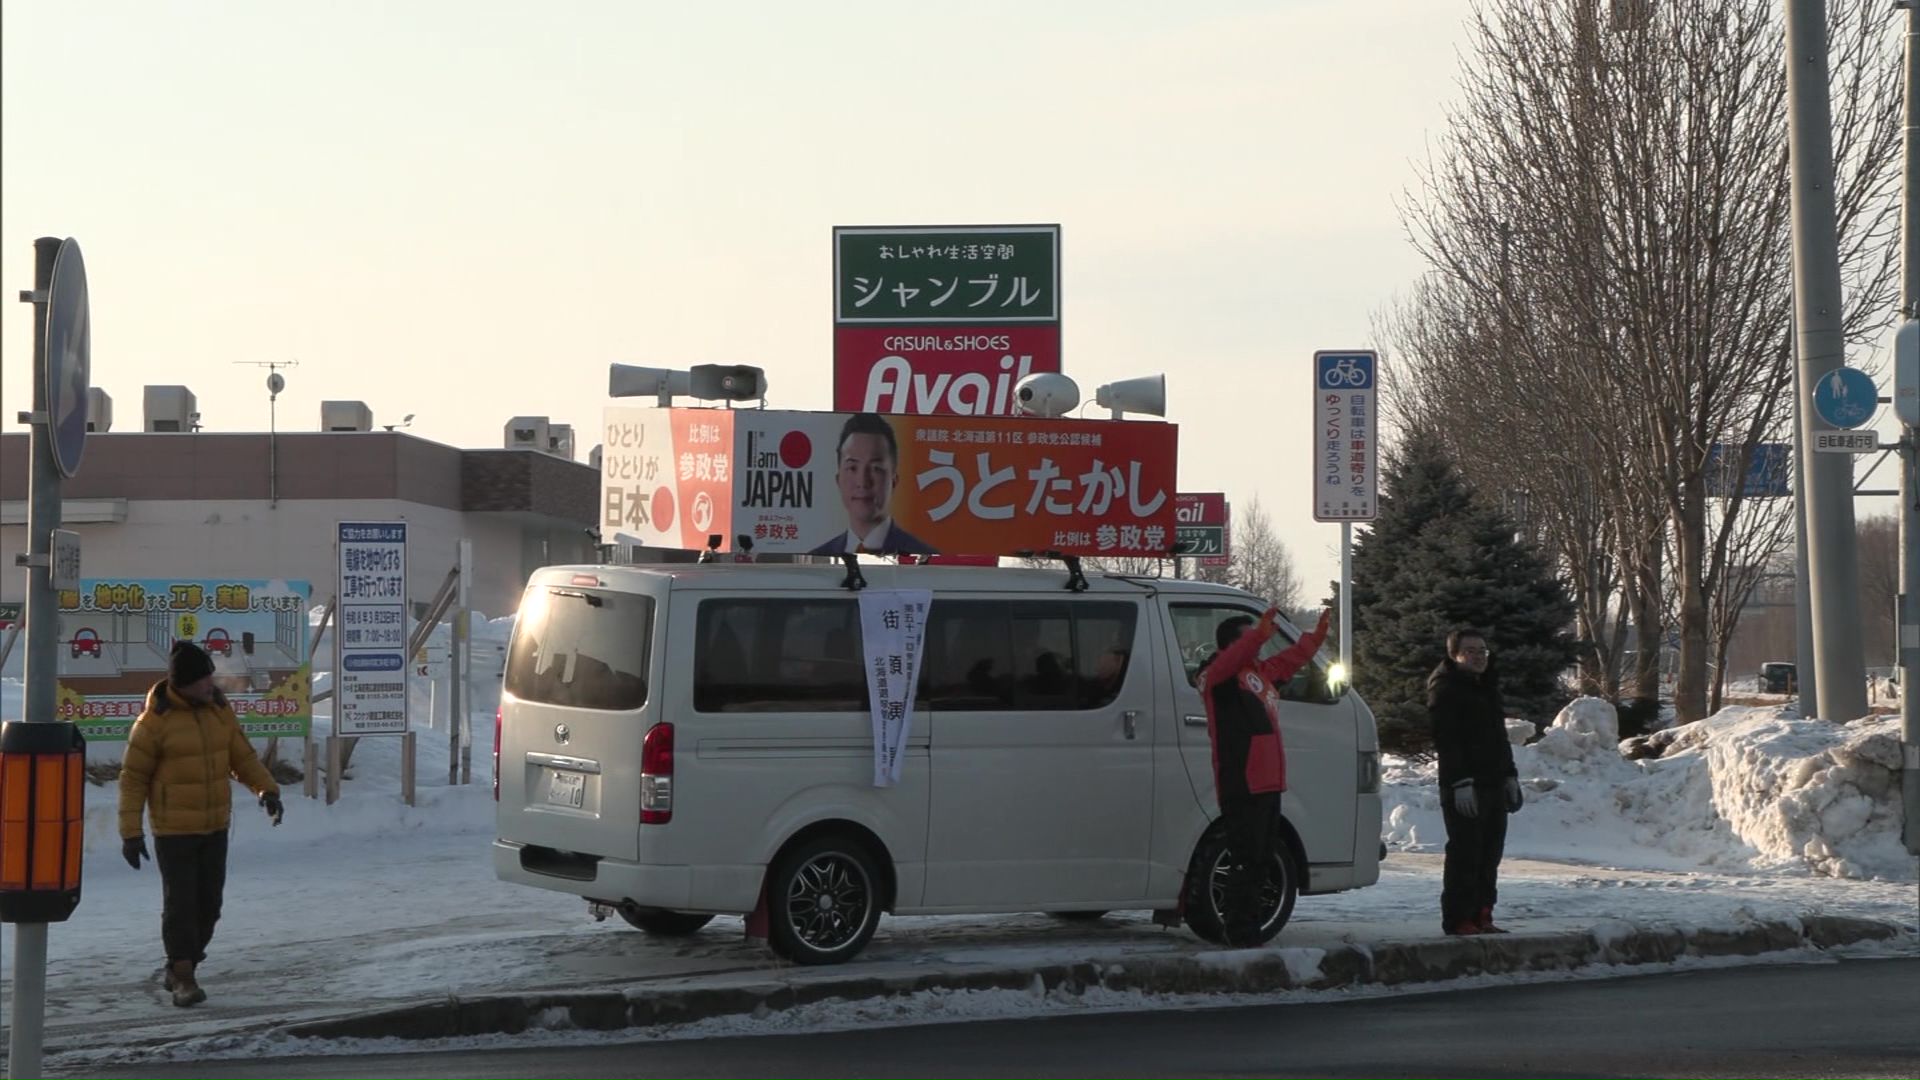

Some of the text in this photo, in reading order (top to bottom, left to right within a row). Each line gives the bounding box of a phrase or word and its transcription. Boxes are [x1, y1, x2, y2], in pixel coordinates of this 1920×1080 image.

[878, 244, 1015, 260] おしゃれ生活空間
[853, 273, 1041, 308] シャンブル
[883, 335, 1011, 351] CASUAL&SHOES
[607, 423, 645, 448] ひとり
[688, 424, 721, 444] 比例は
[953, 430, 1024, 444] 北海道第11区
[1325, 394, 1341, 486] ゆっくり走ろうね
[1350, 394, 1366, 497] 自転車は車道寄りを
[1818, 435, 1873, 449] 自転車通行可
[607, 455, 659, 481] ひとりが
[679, 452, 729, 482] 参政党
[758, 451, 778, 469] am
[741, 470, 813, 508] JAPAN
[605, 485, 650, 531] 日本
[1176, 502, 1205, 522] ail
[754, 523, 799, 540] 参政党
[1054, 524, 1166, 551] 比例は 参政党
[59, 583, 302, 610] 線を地中化する工事を実施しています
[343, 575, 402, 598] 工事を行っています
[183, 623, 194, 636] 後
